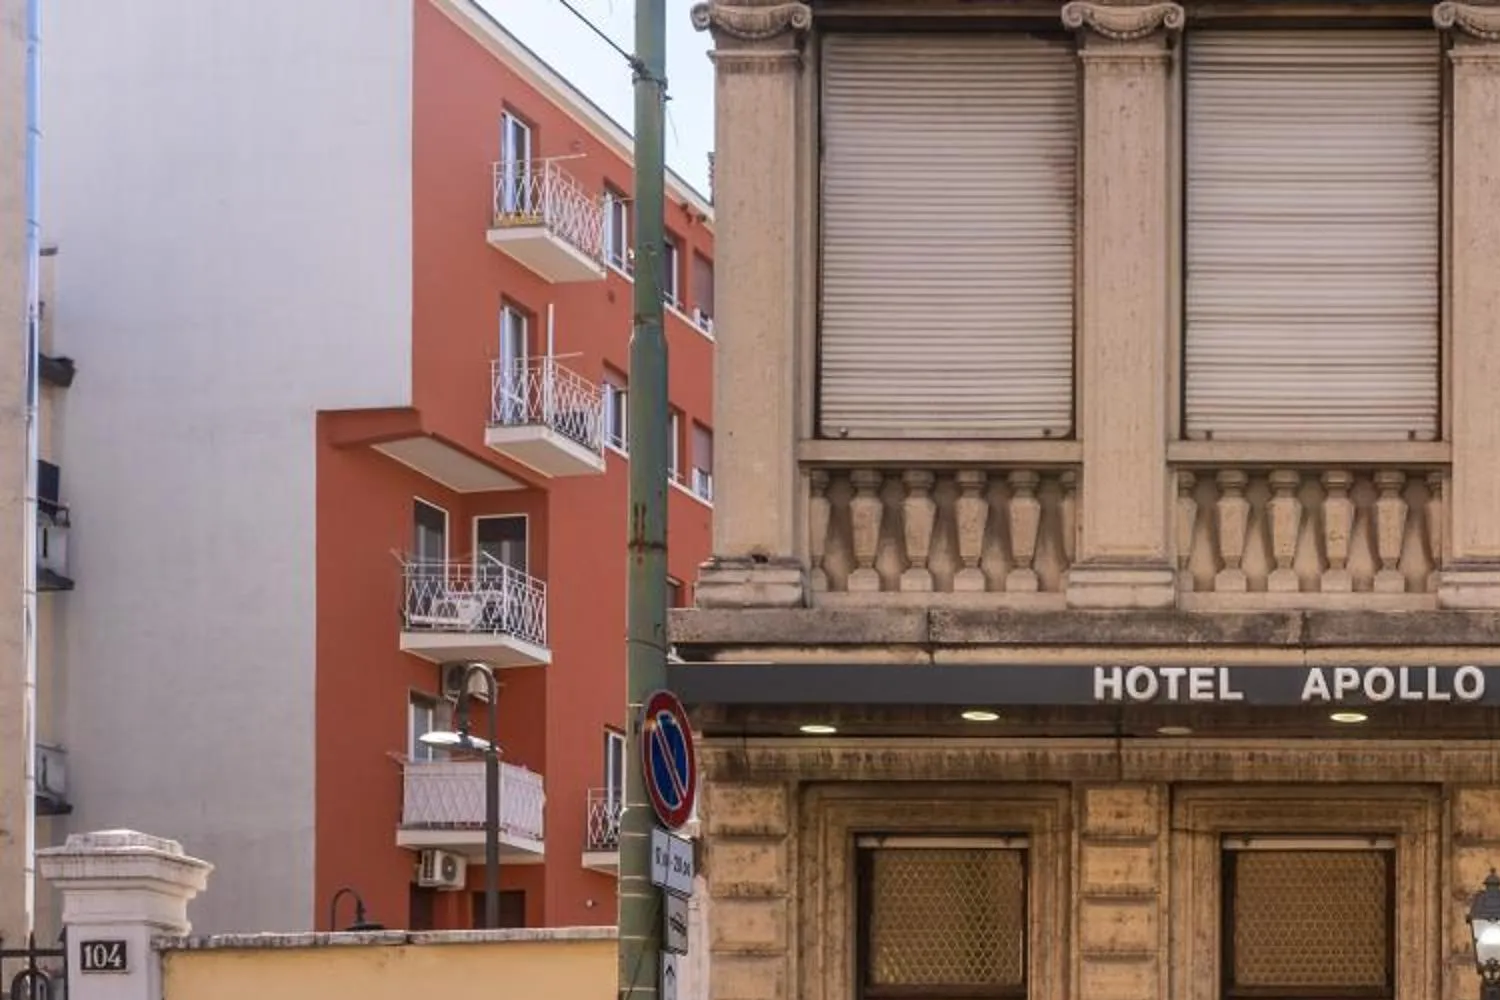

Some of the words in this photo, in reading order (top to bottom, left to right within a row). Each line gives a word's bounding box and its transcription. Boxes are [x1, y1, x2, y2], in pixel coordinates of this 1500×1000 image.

[1093, 666, 1244, 701] HOTEL
[1300, 665, 1486, 701] APOLLO
[84, 943, 123, 969] 104
